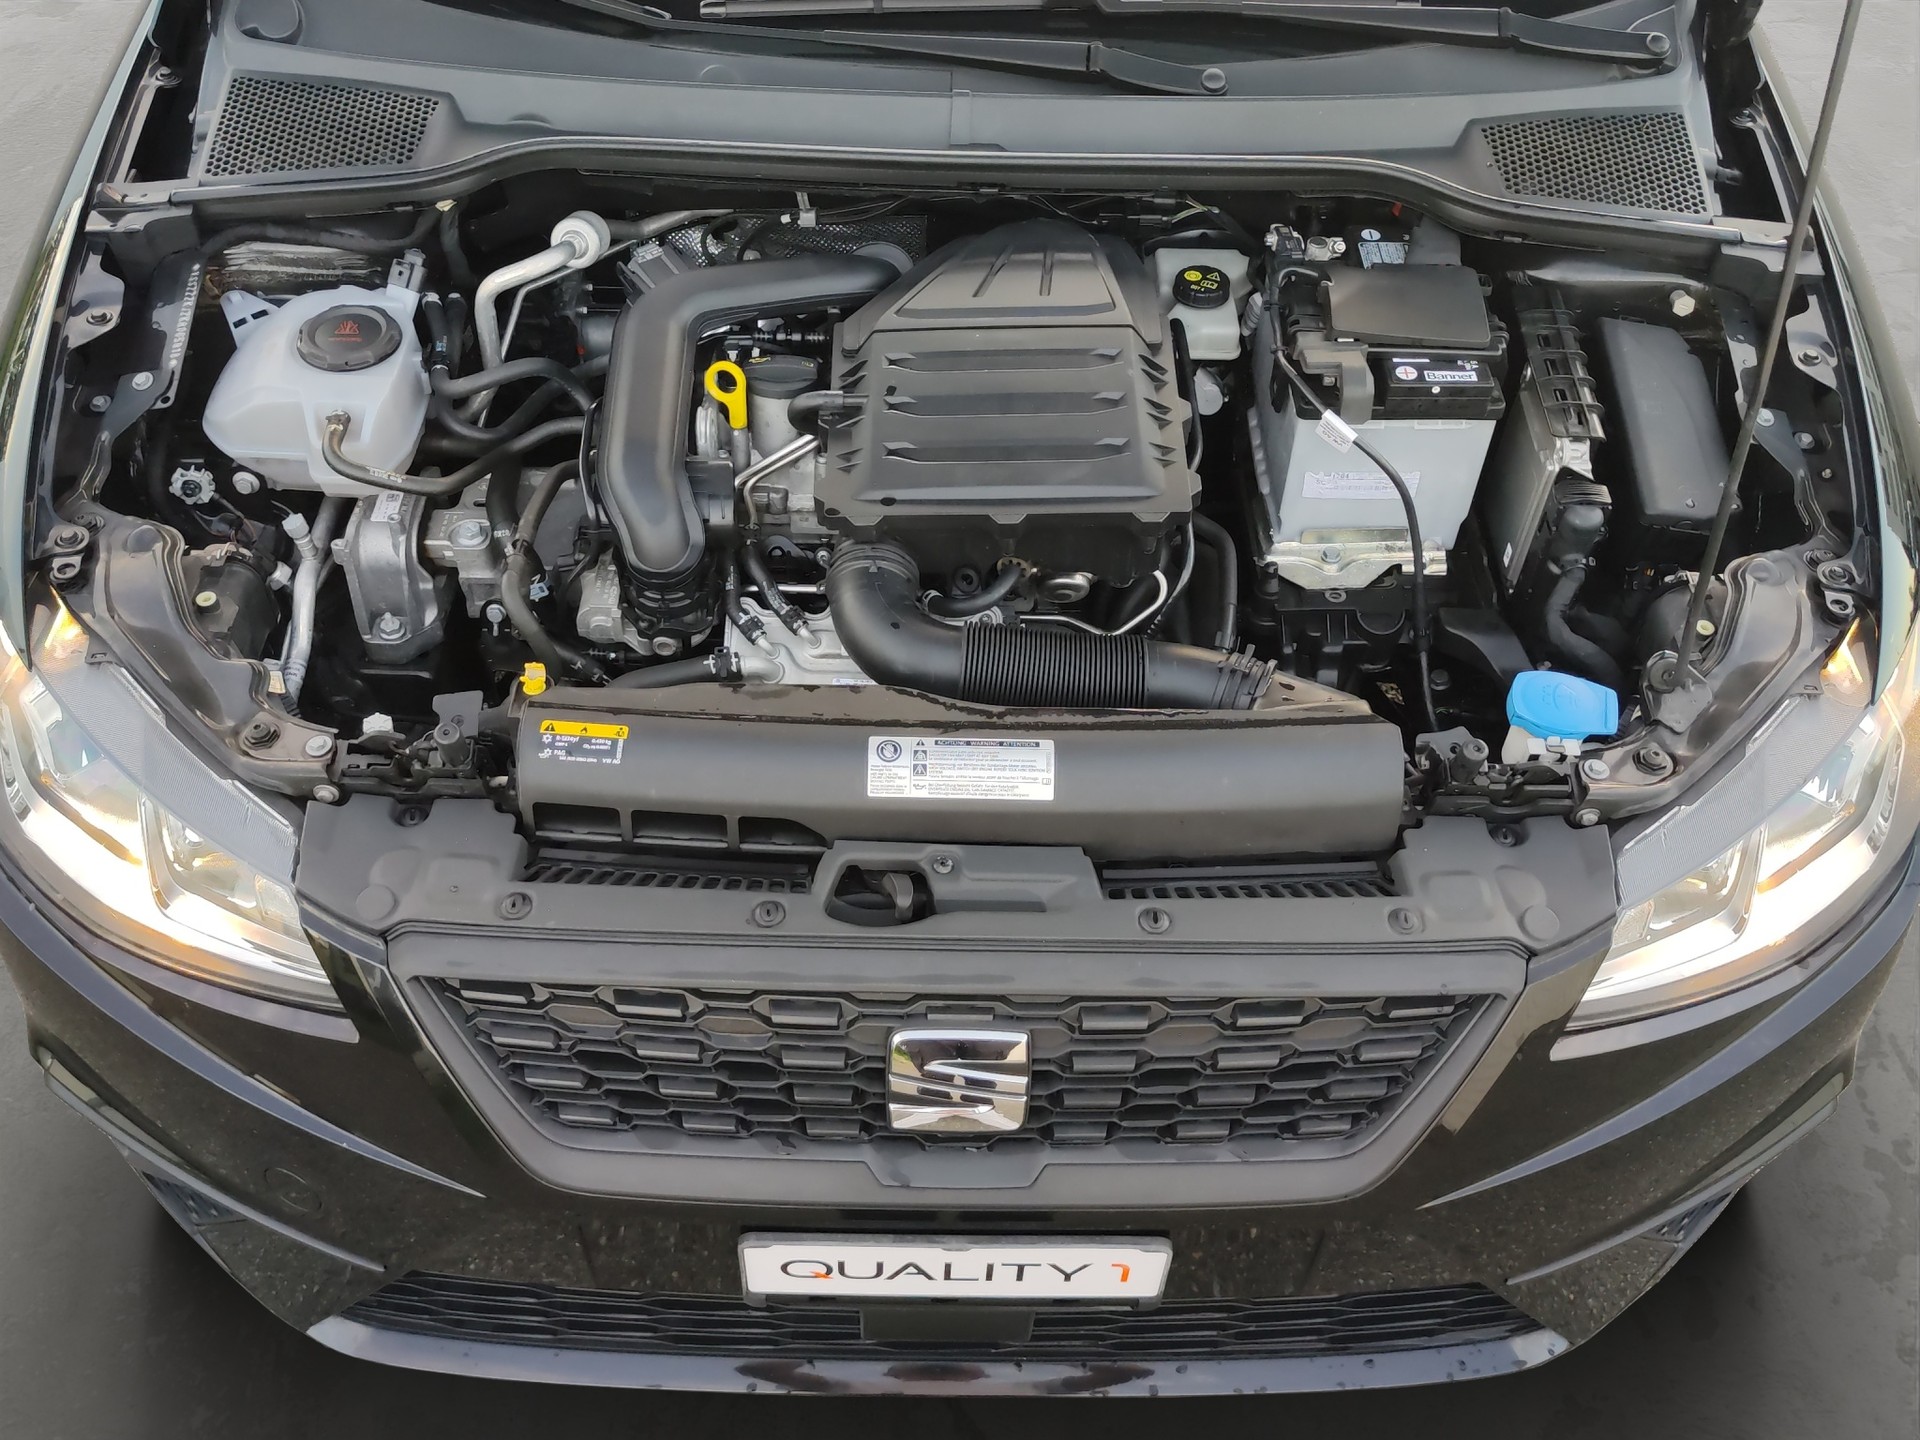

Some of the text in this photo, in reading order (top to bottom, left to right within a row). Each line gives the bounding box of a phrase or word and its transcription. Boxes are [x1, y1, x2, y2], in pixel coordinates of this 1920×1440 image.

[1426, 371, 1475, 381] Banner
[780, 1258, 1130, 1283] QUALITY 1
